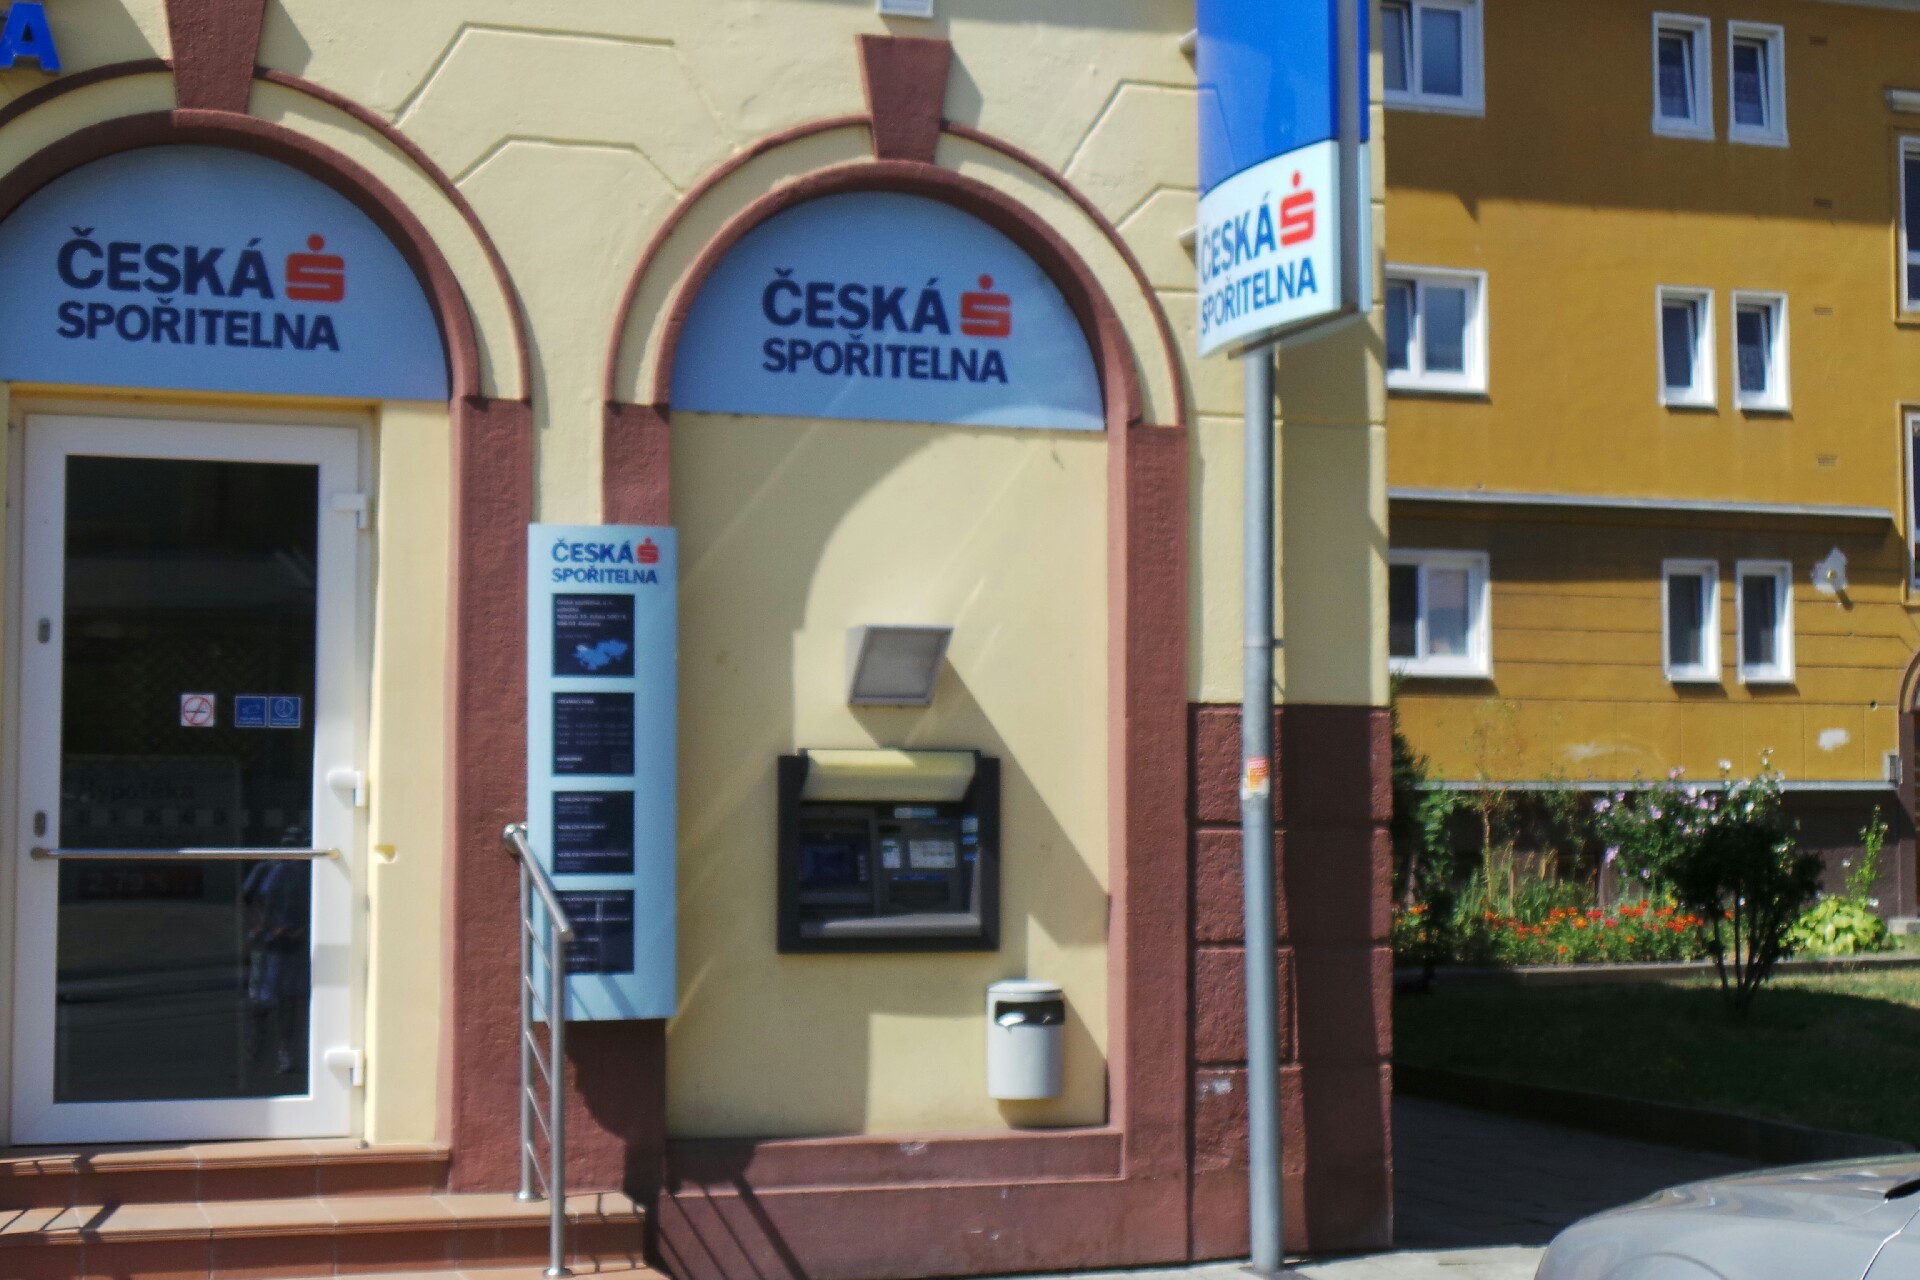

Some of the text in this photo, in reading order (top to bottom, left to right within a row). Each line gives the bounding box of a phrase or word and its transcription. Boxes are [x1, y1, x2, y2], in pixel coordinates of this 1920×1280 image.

[57, 226, 275, 300] ČESKÁ
[1201, 190, 1277, 285] ČESKÁ
[56, 297, 340, 351] SPOŘITELNA
[762, 267, 951, 335] ČESKÁ
[1202, 257, 1318, 336] SPOŘITELNA
[762, 334, 1008, 384] SPOŘITELNA
[551, 538, 634, 563] ČESKÁ
[551, 565, 658, 584] SPOŘITELNA
